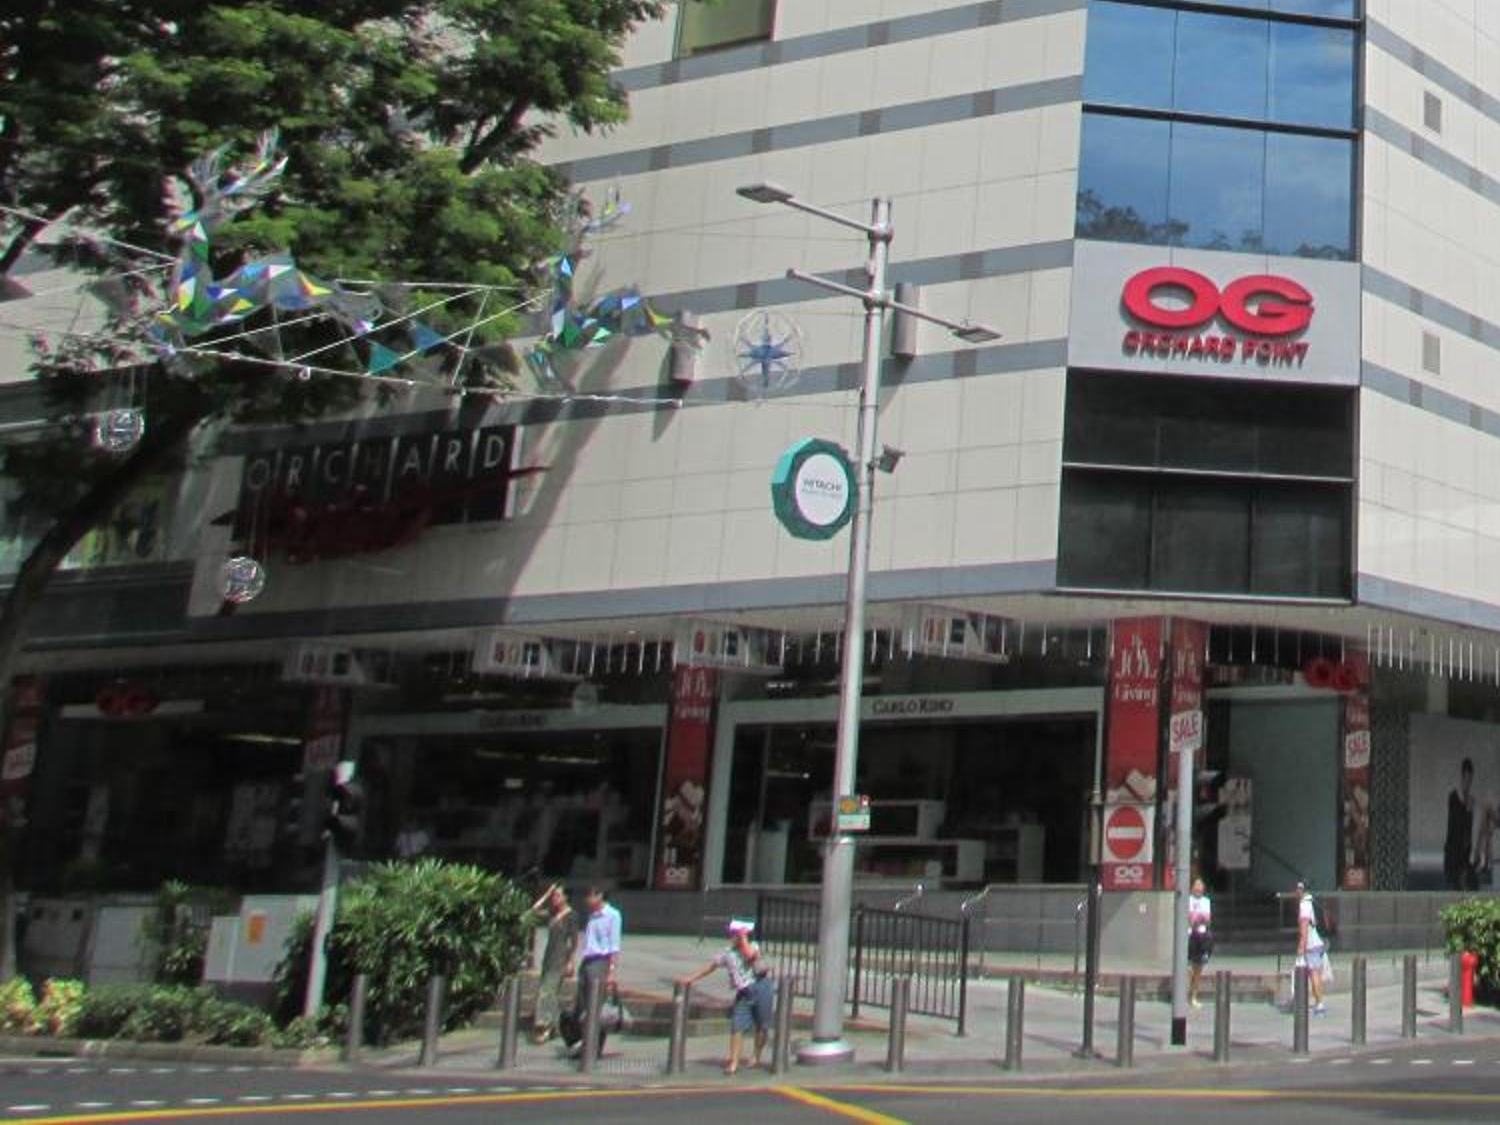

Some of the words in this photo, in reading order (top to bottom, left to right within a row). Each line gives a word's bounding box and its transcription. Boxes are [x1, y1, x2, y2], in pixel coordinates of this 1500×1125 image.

[1121, 266, 1314, 336] OG
[1122, 331, 1237, 362] ORCHARD
[1242, 339, 1309, 367] POINT
[246, 434, 505, 491] ORCHARD
